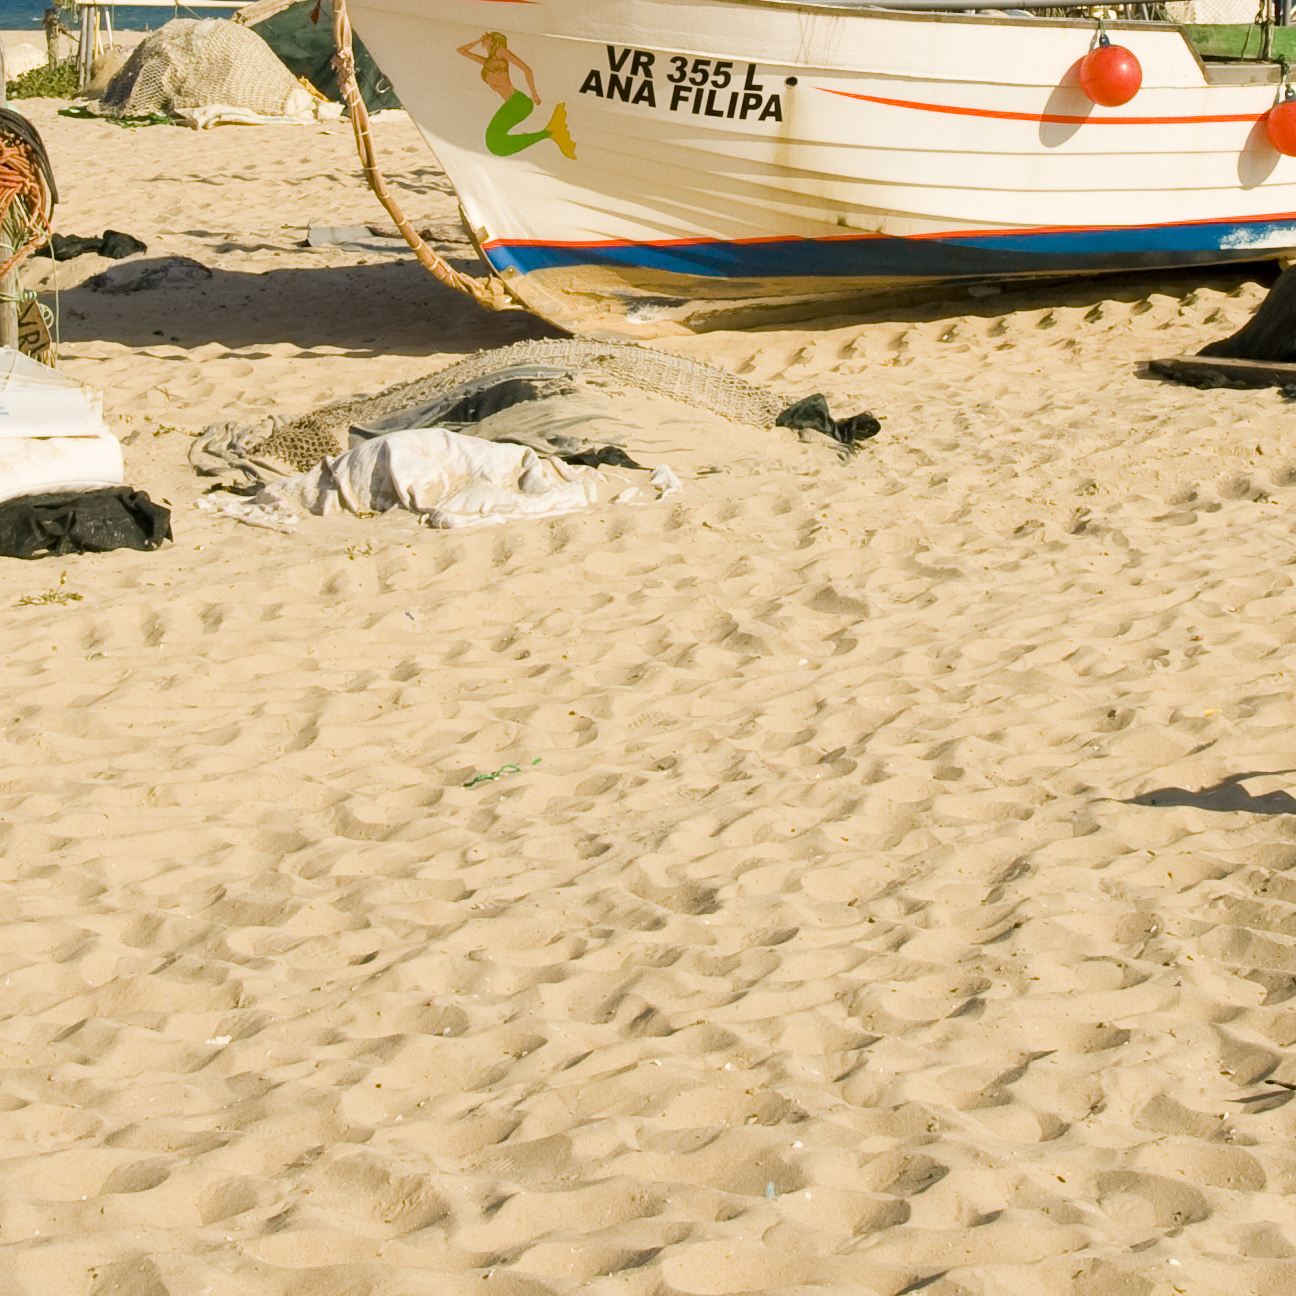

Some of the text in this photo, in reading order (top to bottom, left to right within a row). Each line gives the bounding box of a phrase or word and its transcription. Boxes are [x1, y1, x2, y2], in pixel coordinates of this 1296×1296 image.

[606, 45, 764, 92] VR 355 L
[579, 69, 783, 122] ANA FILIPA
